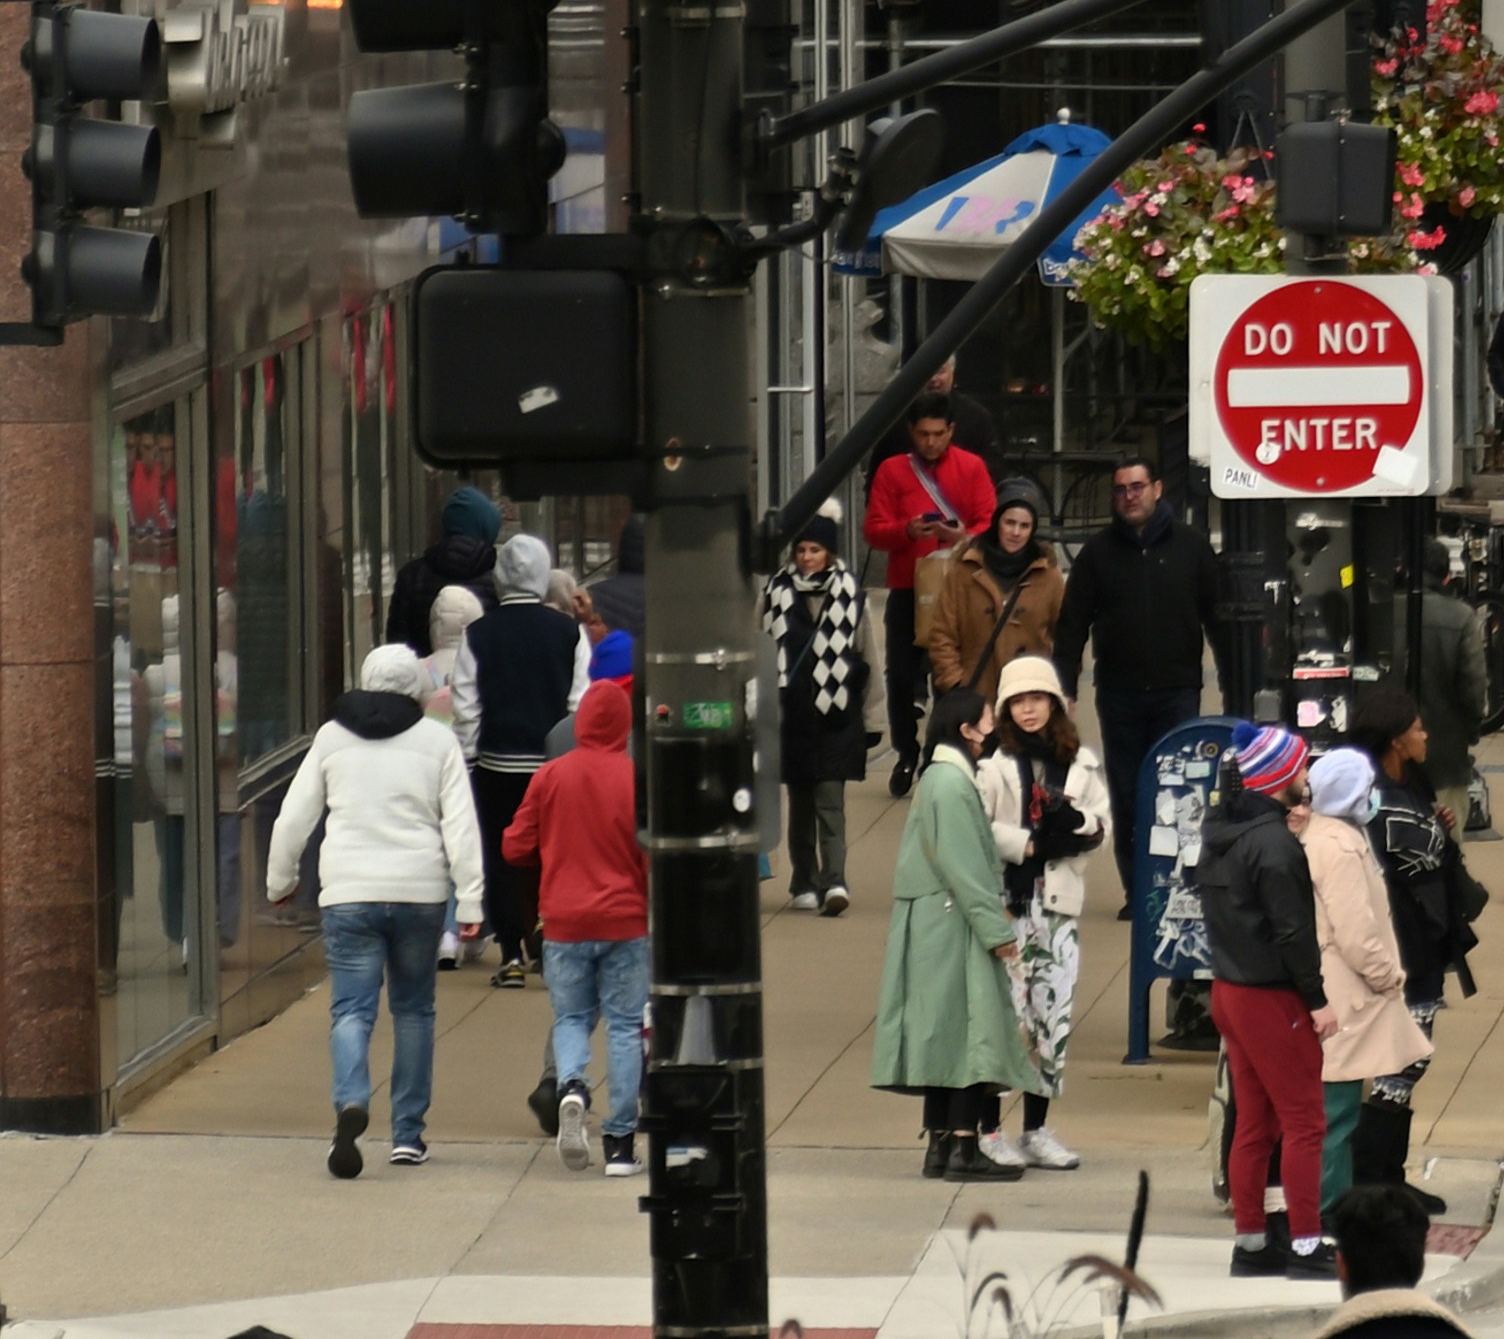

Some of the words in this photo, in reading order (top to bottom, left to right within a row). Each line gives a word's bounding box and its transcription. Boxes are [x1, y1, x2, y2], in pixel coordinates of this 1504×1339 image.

[1244, 323, 1293, 356] DO
[1318, 321, 1392, 355] NOT
[1260, 417, 1378, 451] ENTER
